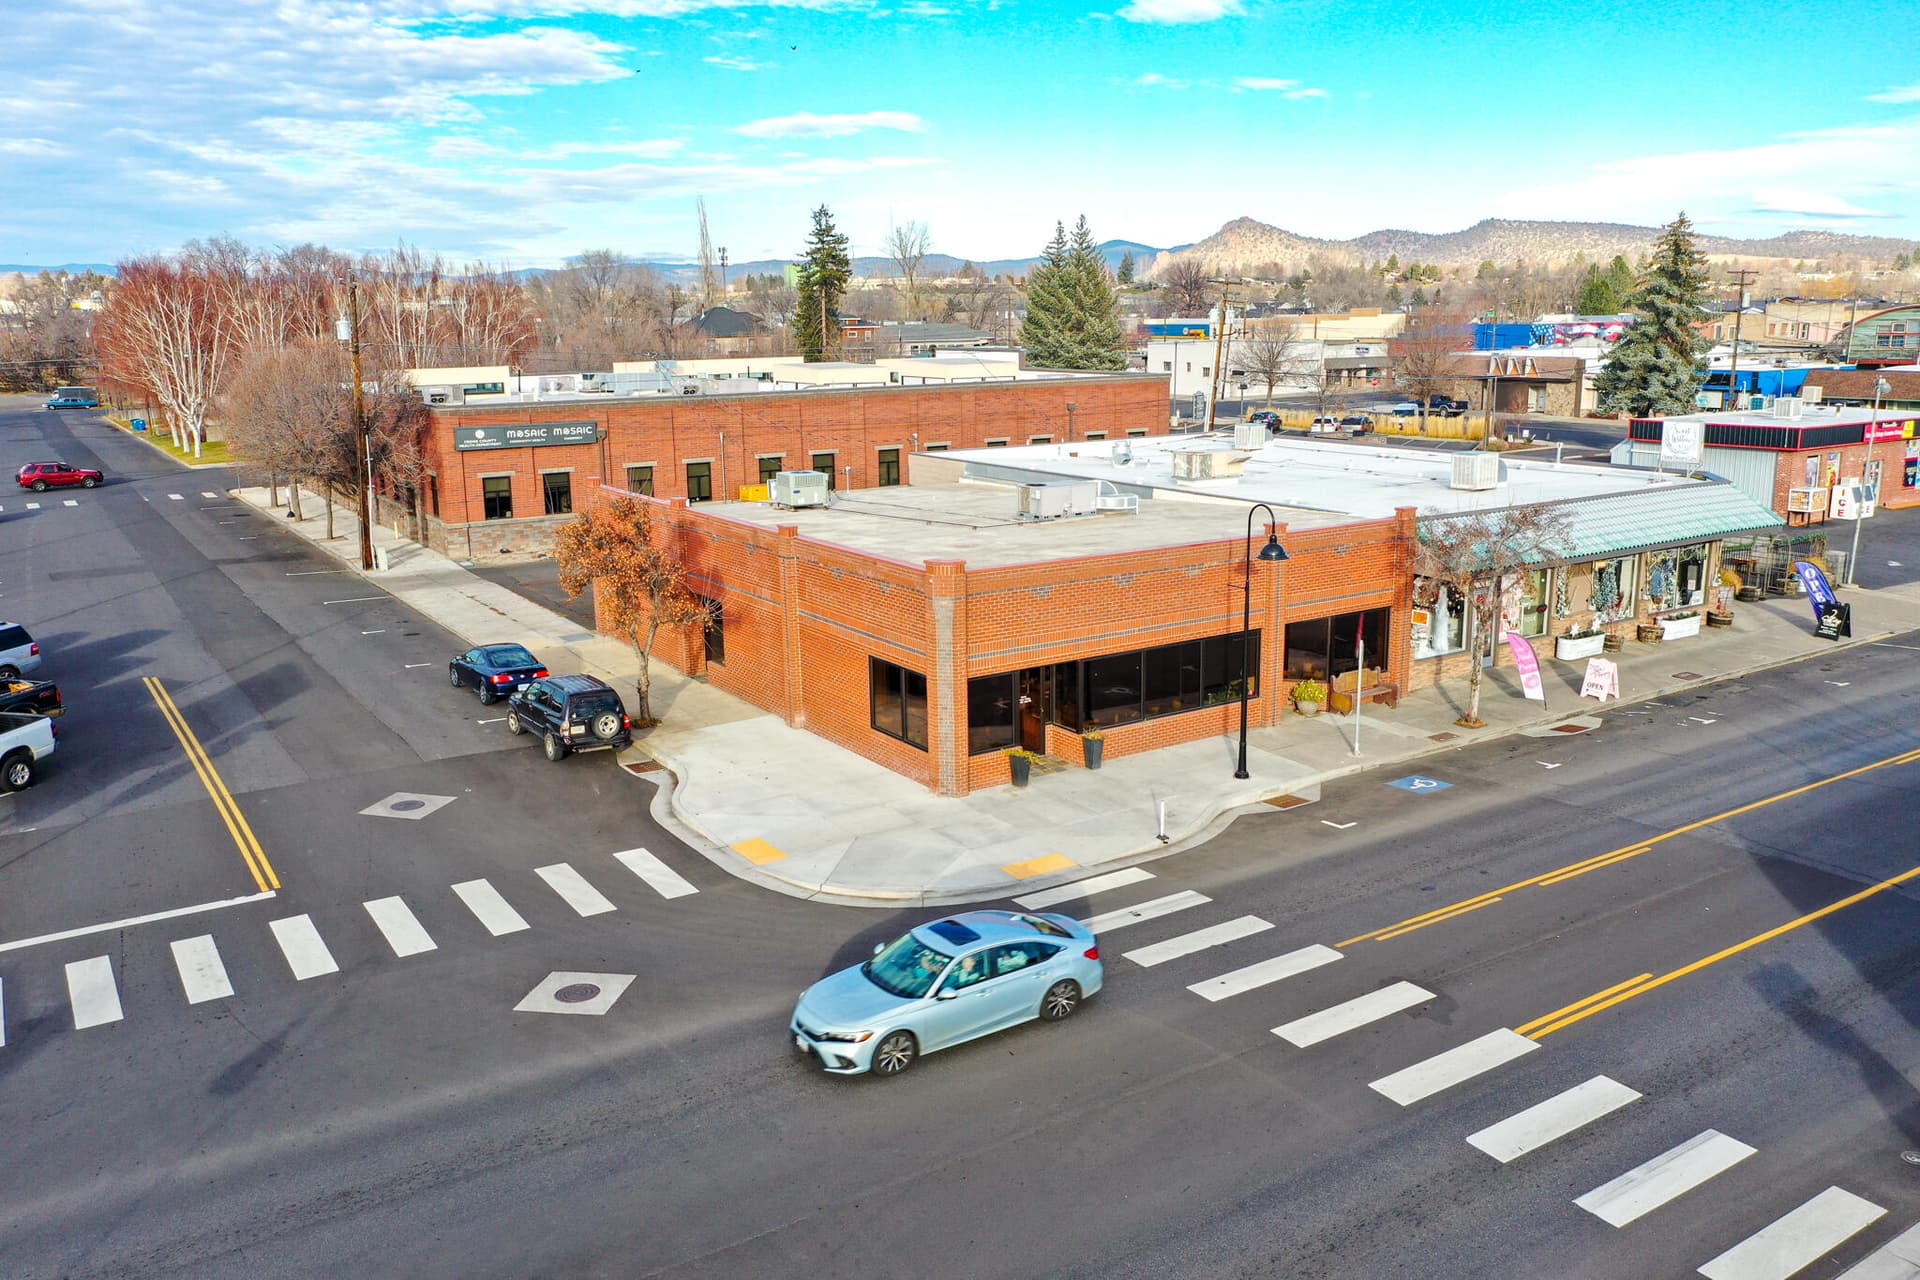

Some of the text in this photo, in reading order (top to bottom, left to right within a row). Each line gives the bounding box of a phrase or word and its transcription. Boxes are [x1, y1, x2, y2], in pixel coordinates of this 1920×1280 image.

[1838, 489, 1847, 516] ICE
[1804, 567, 1826, 608] OPE
[1587, 681, 1603, 691] OPEN
